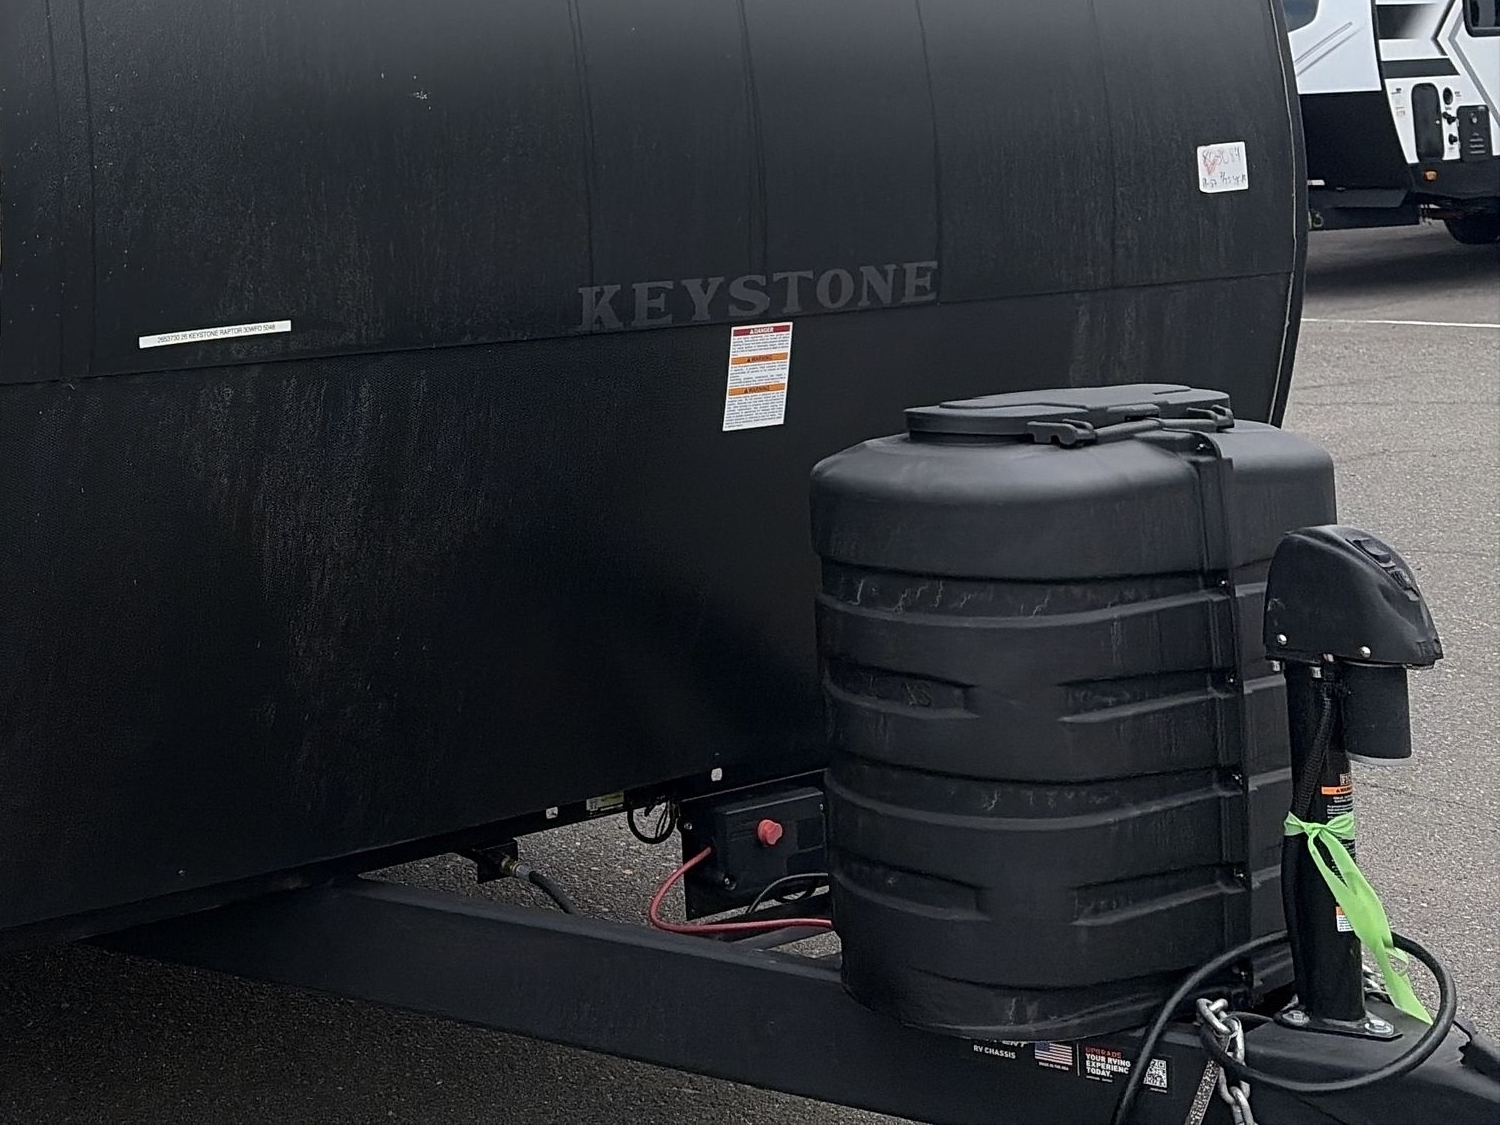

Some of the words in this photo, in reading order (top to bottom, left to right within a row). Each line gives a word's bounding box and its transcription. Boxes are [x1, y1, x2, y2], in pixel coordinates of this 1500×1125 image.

[577, 260, 939, 332] KEYSTONE
[188, 329, 219, 340] KEYSTONE
[219, 326, 243, 336] RAPTOR
[973, 1044, 983, 1053] RV
[984, 1047, 1016, 1059] CHASSIS
[1085, 1053, 1106, 1063] YOUR
[1107, 1057, 1131, 1068] RVING
[1085, 1060, 1130, 1074] EXPERIENC
[1086, 1066, 1113, 1078] TODAY.
